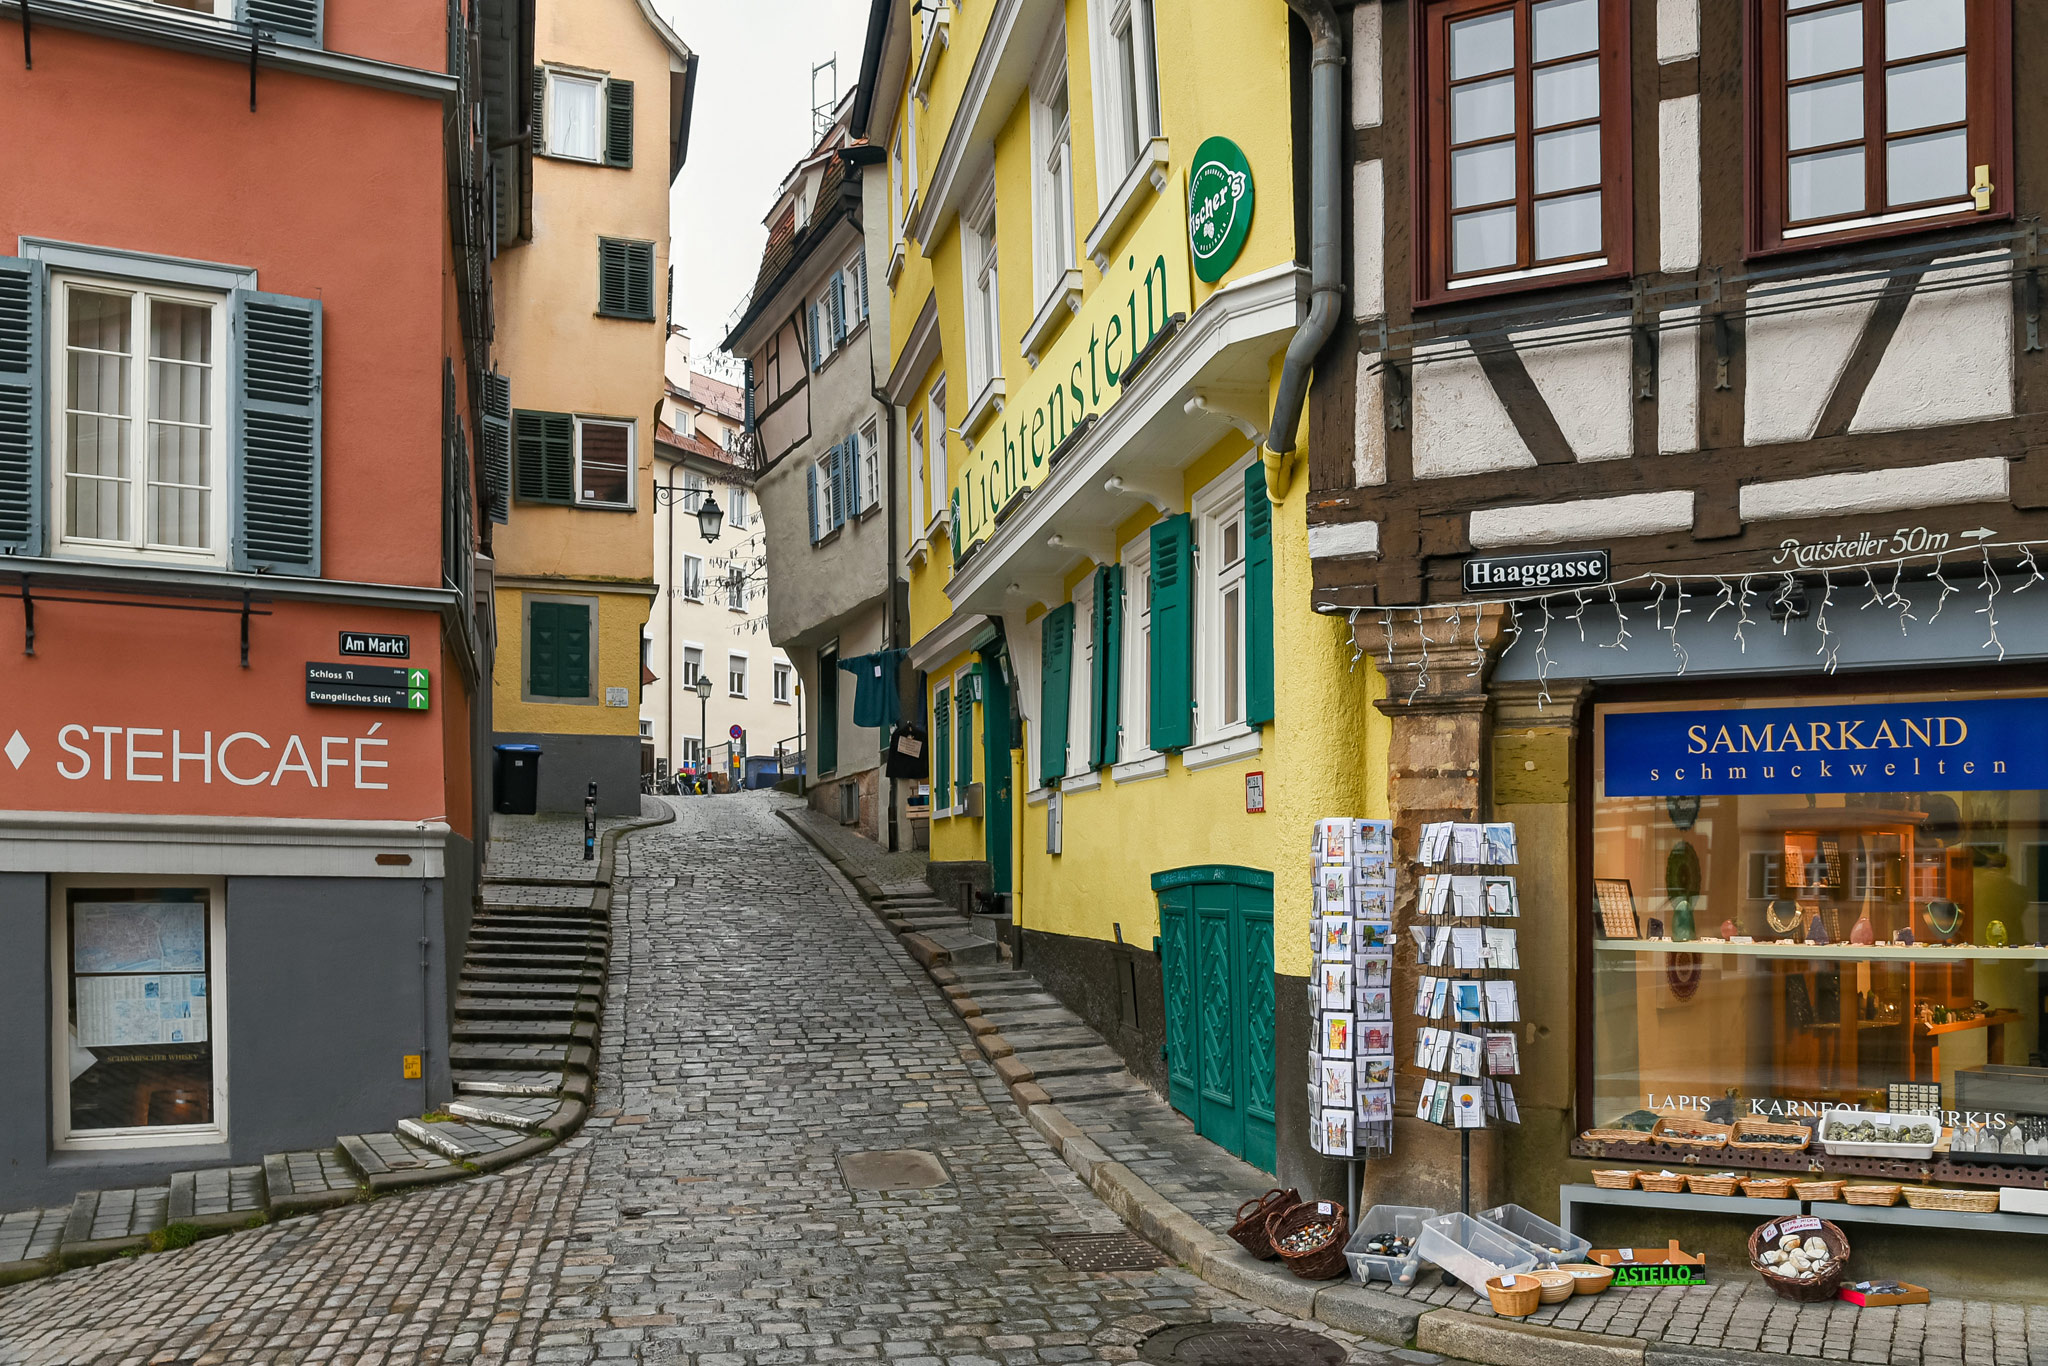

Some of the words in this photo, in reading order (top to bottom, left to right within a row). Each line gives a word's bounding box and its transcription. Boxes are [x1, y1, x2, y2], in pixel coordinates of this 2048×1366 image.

[965, 254, 1171, 543] Lichtenstein
[1772, 531, 1888, 568] Ratskeller
[1890, 526, 1949, 554] 50m
[1470, 559, 1602, 587] Haaggasse
[345, 636, 365, 652] Am
[368, 637, 404, 654] Markt
[309, 669, 343, 680] Schloss
[310, 691, 371, 703] Evangelisches
[373, 694, 392, 704] Stift
[1687, 716, 1968, 755] SAMARKAND
[56, 722, 389, 790] STEHCAFÉ
[1650, 757, 2007, 782] schmuckwelten
[1647, 1093, 1711, 1112] LAPIS
